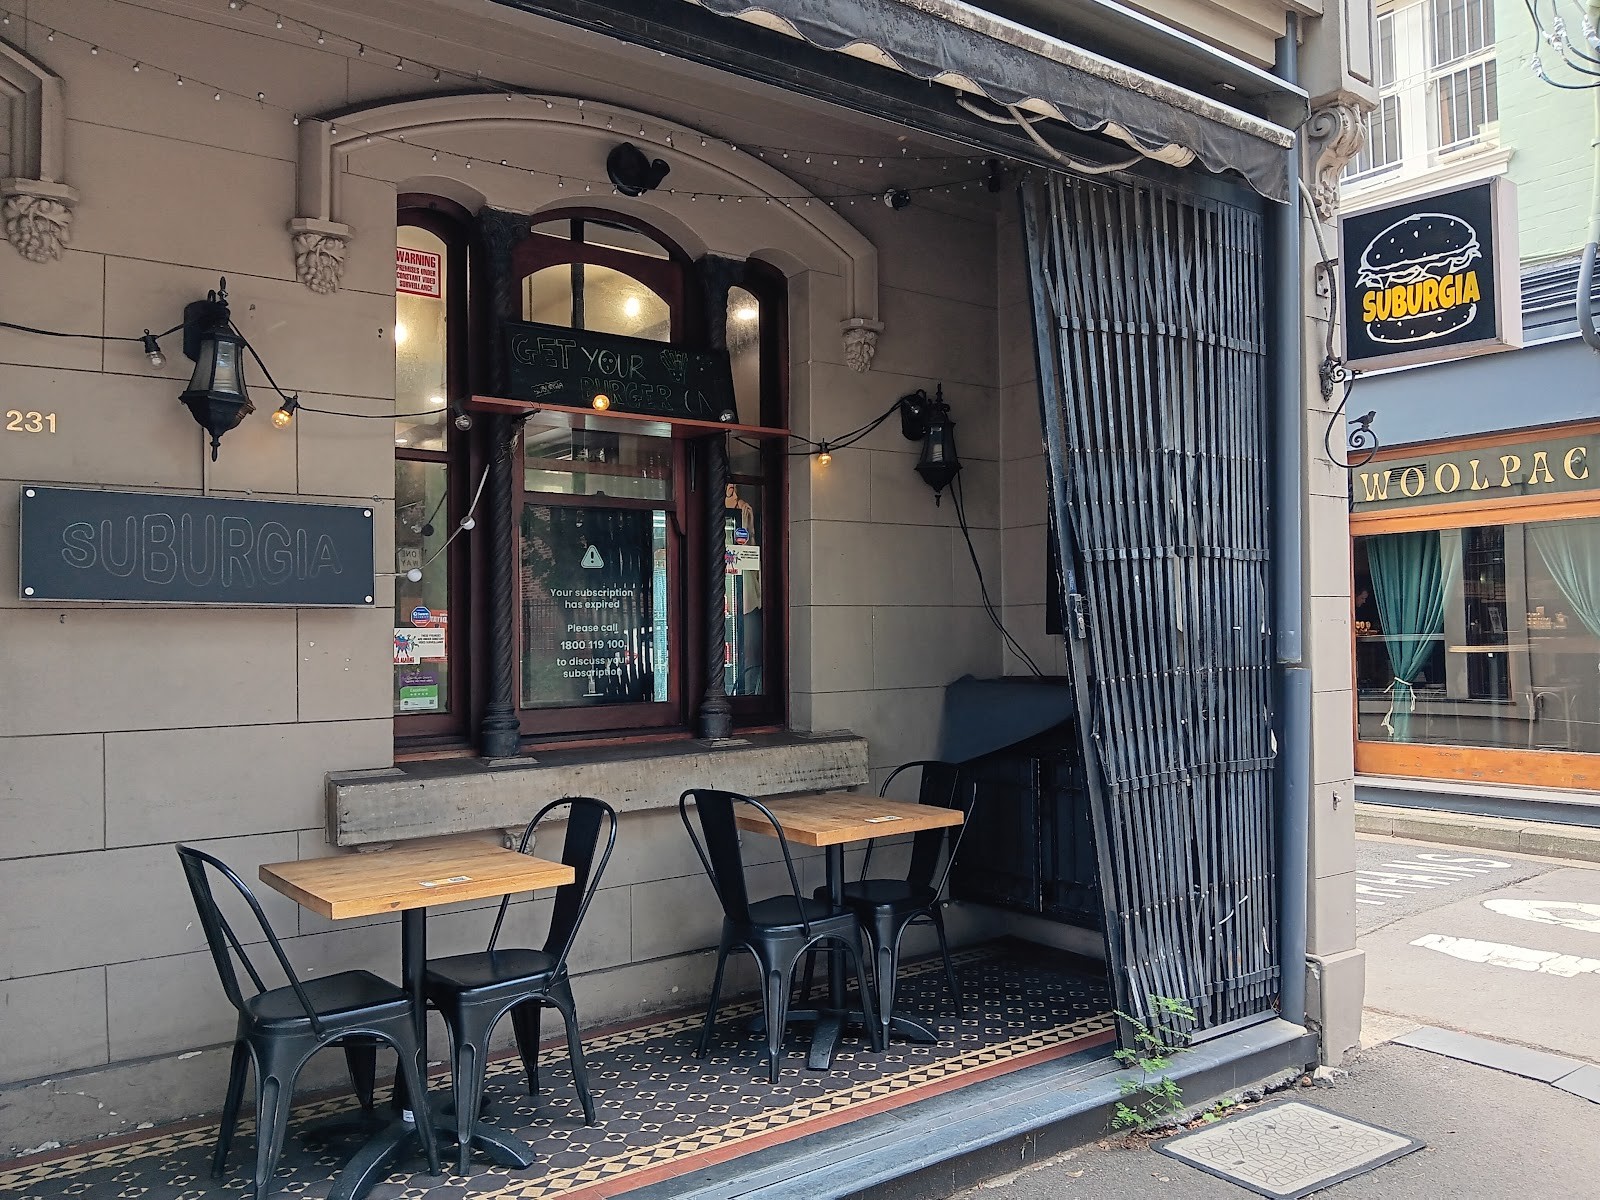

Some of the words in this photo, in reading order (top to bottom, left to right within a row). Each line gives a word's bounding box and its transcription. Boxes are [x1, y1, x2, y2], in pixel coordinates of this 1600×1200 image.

[396, 250, 436, 268] WARNING
[396, 264, 420, 274] PREMISES
[421, 268, 436, 277] UNDER
[396, 272, 421, 282] CONSTANT
[422, 276, 436, 285] VIDEO
[399, 280, 433, 292] SURVEILLANCE
[1362, 270, 1481, 324] SUBURGIA
[511, 333, 577, 370] GET
[581, 346, 646, 380] YOUR
[580, 377, 674, 411] BURGER
[6, 409, 58, 434] 231
[61, 513, 344, 588] SUBURGIA
[550, 588, 573, 597] Your
[575, 588, 634, 600] subscription
[565, 600, 583, 609] has
[584, 600, 620, 611] expired
[567, 624, 598, 633] Please
[601, 623, 618, 632] call
[560, 640, 586, 650] 1800
[588, 640, 604, 649] 119
[556, 658, 567, 667] to
[568, 657, 605, 666] discuss
[563, 669, 623, 679] subscription
